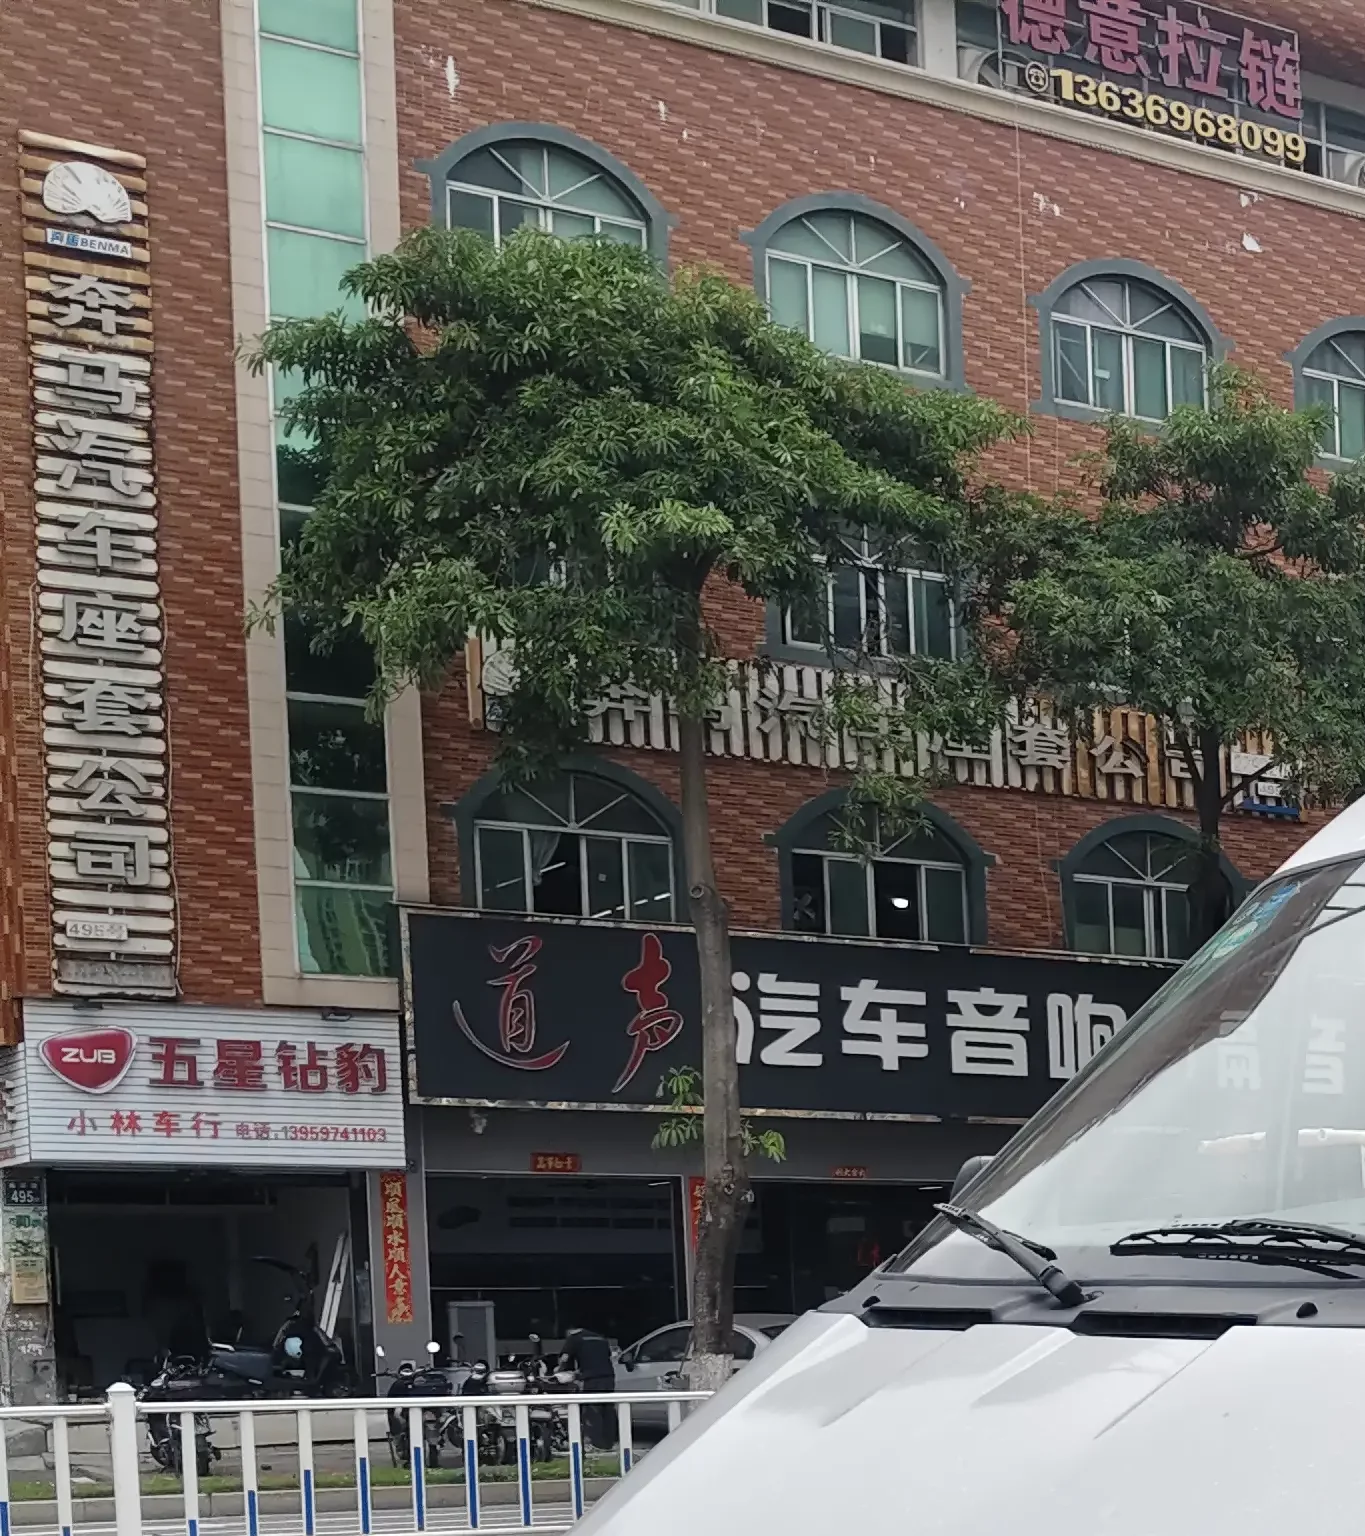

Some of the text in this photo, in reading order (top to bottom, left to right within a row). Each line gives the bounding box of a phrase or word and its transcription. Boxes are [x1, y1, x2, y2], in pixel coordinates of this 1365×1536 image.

[1001, 0, 1304, 119] 德意拉链
[1050, 69, 1307, 162] 13636968099
[80, 237, 129, 256] BENMA
[48, 273, 153, 886] 奔马汽车座套公司
[61, 1047, 117, 1065] ZUB
[148, 1036, 388, 1094] 五星钻豹
[67, 1109, 222, 1138] 小林车行
